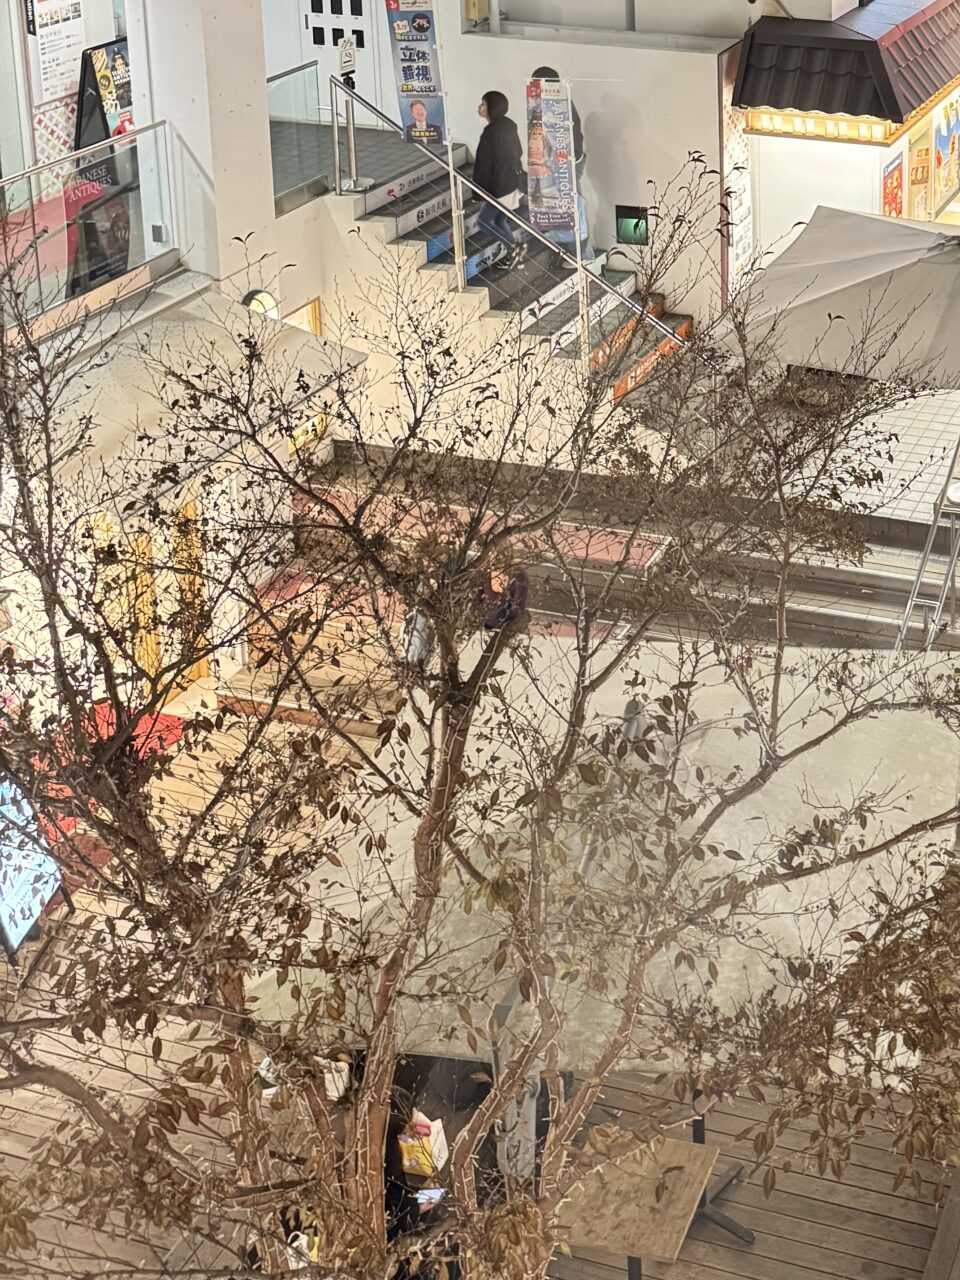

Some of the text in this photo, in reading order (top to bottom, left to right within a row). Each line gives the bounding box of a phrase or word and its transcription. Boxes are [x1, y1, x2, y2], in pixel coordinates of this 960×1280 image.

[400, 44, 431, 64] 立体
[551, 101, 567, 155] JAPANESE
[69, 174, 113, 203] ANTIQUES
[558, 156, 573, 210] ANTIQUES
